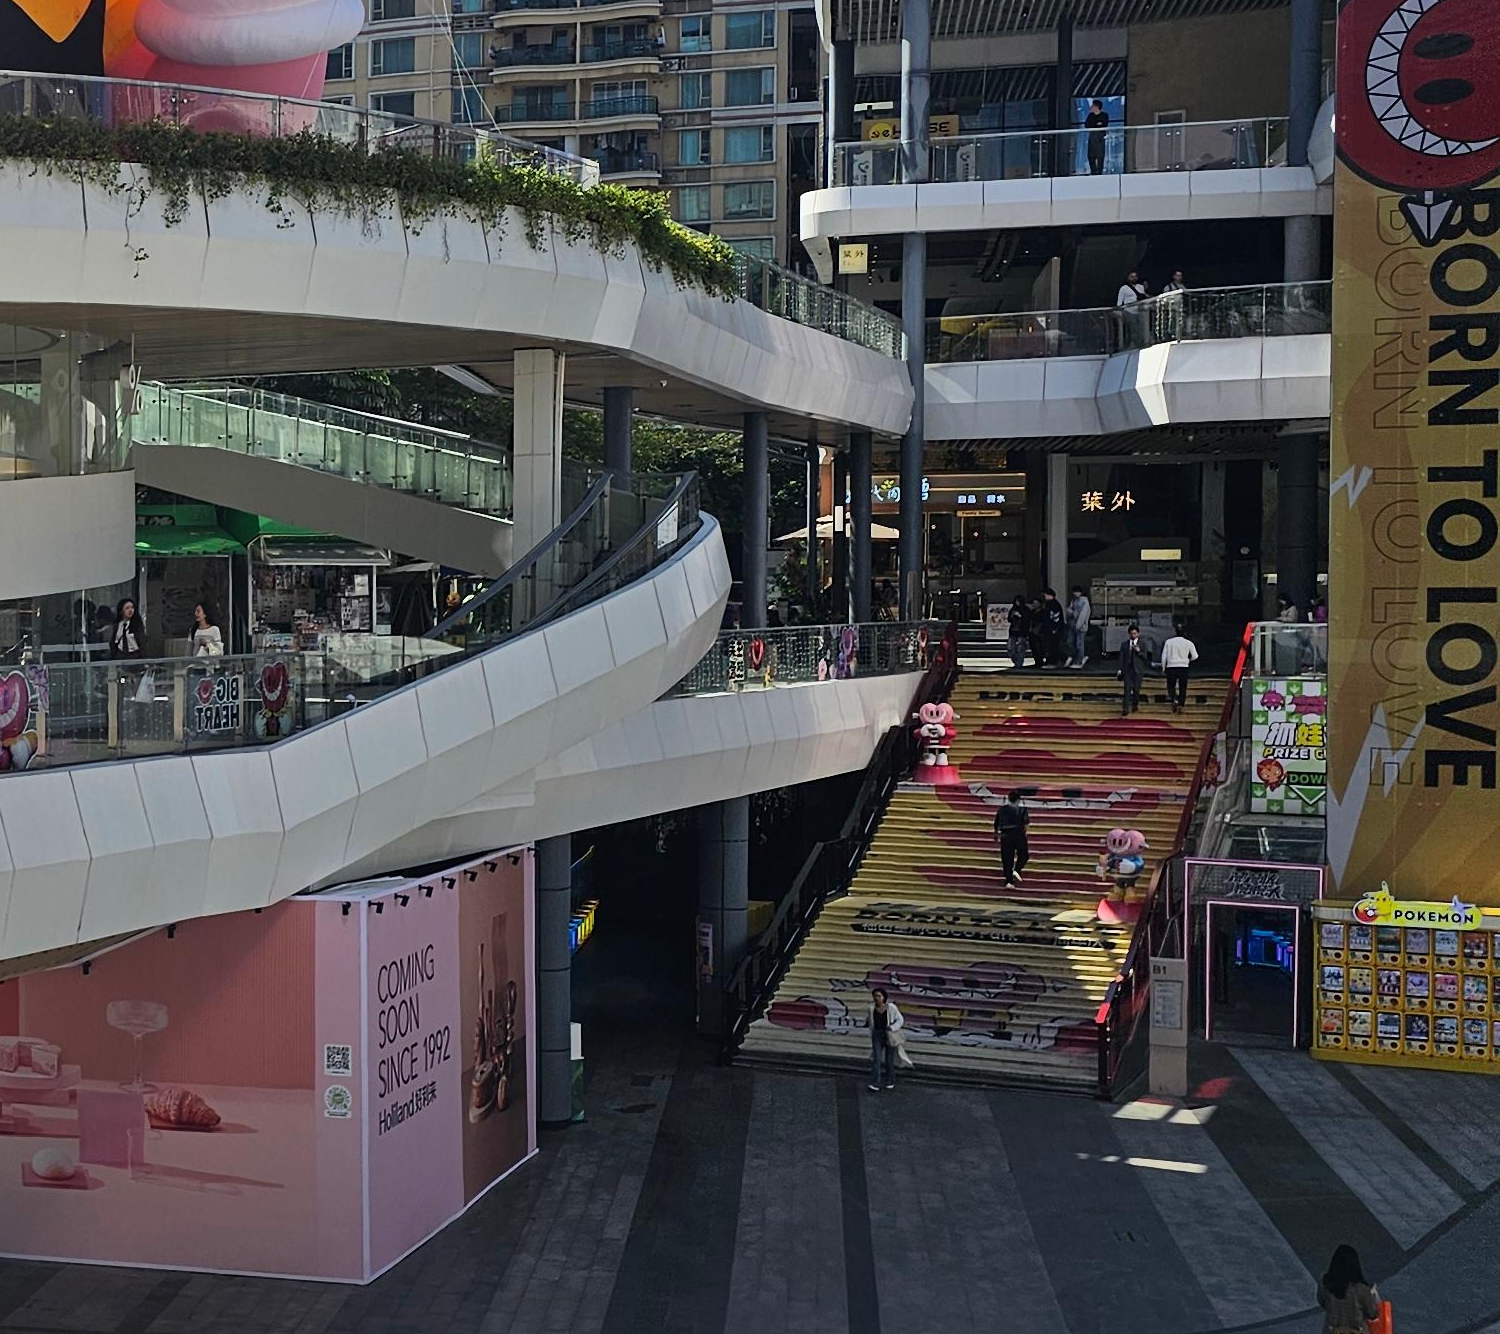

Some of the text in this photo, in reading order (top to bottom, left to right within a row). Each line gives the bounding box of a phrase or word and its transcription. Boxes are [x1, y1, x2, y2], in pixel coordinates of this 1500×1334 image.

[1424, 188, 1500, 789] BORN TO LOVE
[1263, 748, 1309, 759] PRIZE
[1264, 722, 1326, 747] 抓娃
[1393, 909, 1474, 924] POKEMON
[378, 944, 435, 1003] COMING
[378, 993, 420, 1049] SOON
[378, 1025, 451, 1099] SINCE 1992
